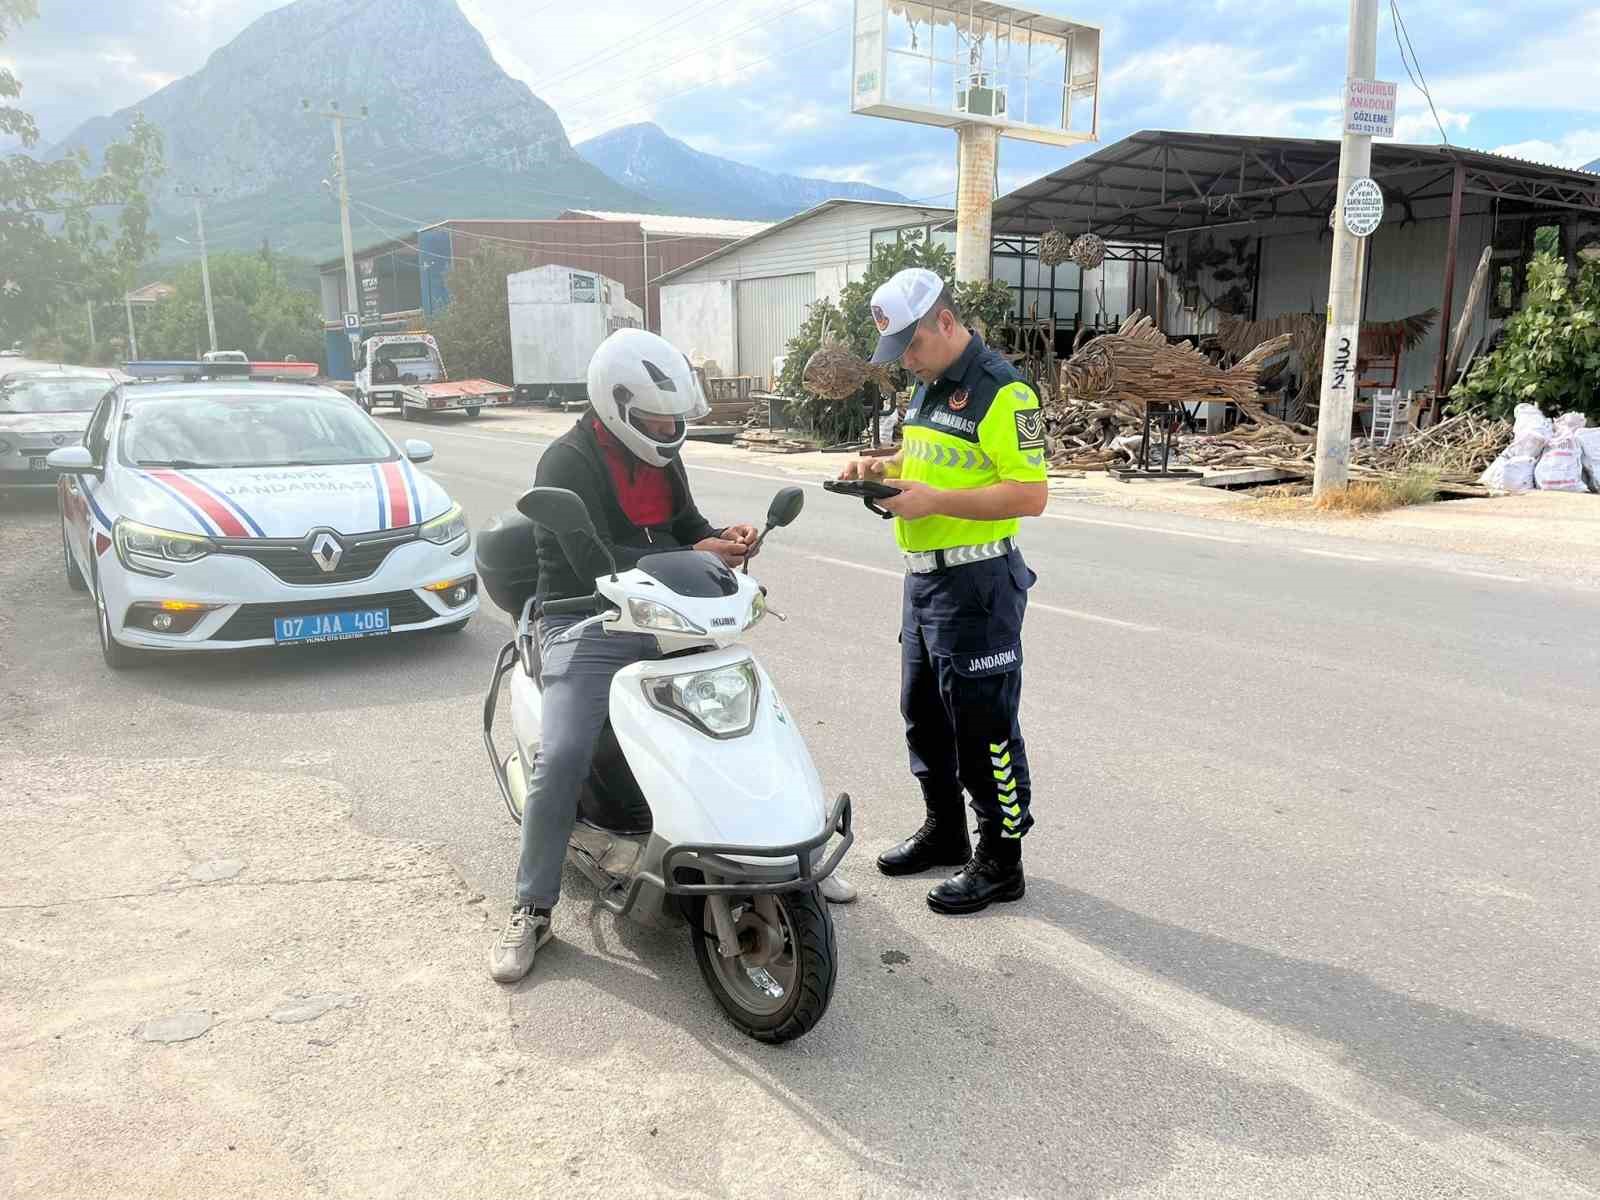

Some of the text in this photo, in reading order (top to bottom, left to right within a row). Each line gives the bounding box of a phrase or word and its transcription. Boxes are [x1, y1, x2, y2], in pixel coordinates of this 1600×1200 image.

[1353, 110, 1388, 124] GÖZLEME
[282, 611, 385, 637] 07 JAA 406
[968, 648, 1017, 672] JANDARMA
